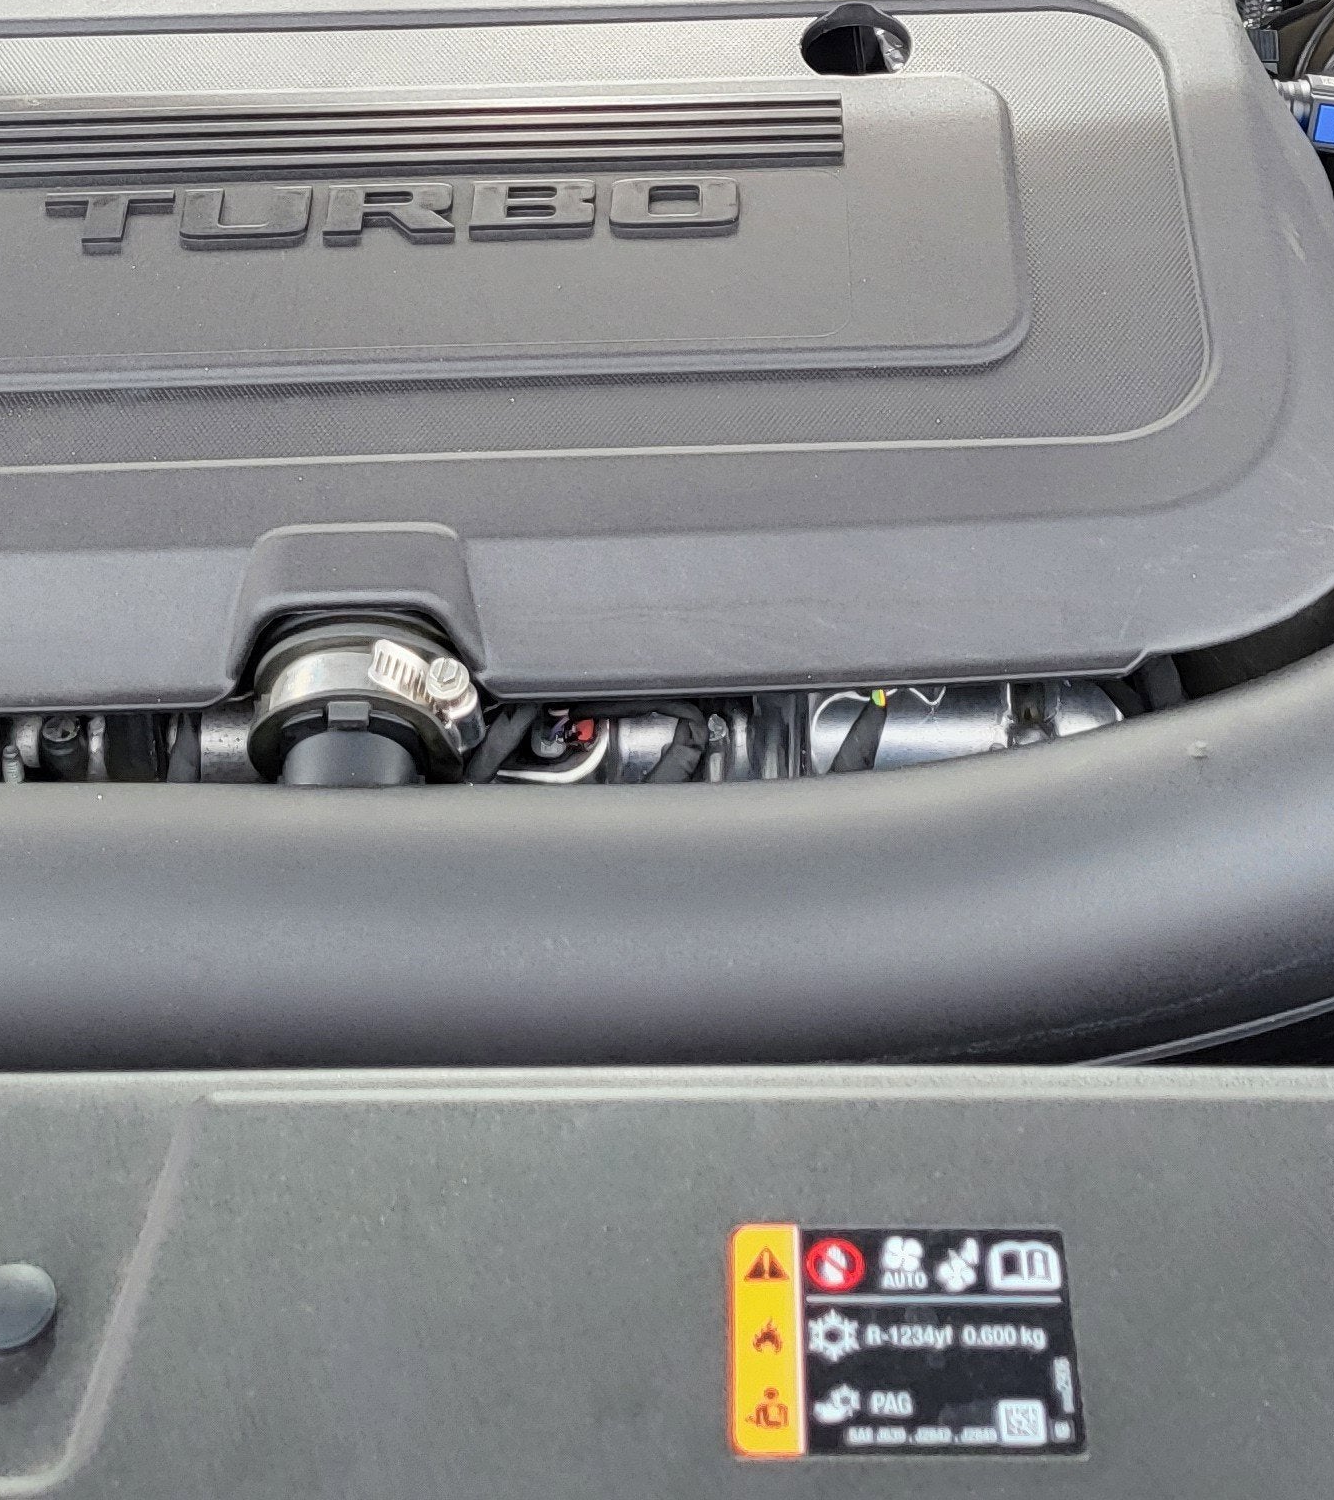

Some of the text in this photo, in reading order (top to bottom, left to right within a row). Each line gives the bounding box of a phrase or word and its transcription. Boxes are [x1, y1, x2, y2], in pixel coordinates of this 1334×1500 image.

[45, 176, 740, 254] TURBO
[881, 1272, 928, 1290] AUTO
[866, 1324, 1048, 1350] R-1234yf 0.600 kg
[869, 1390, 914, 1416] PAG
